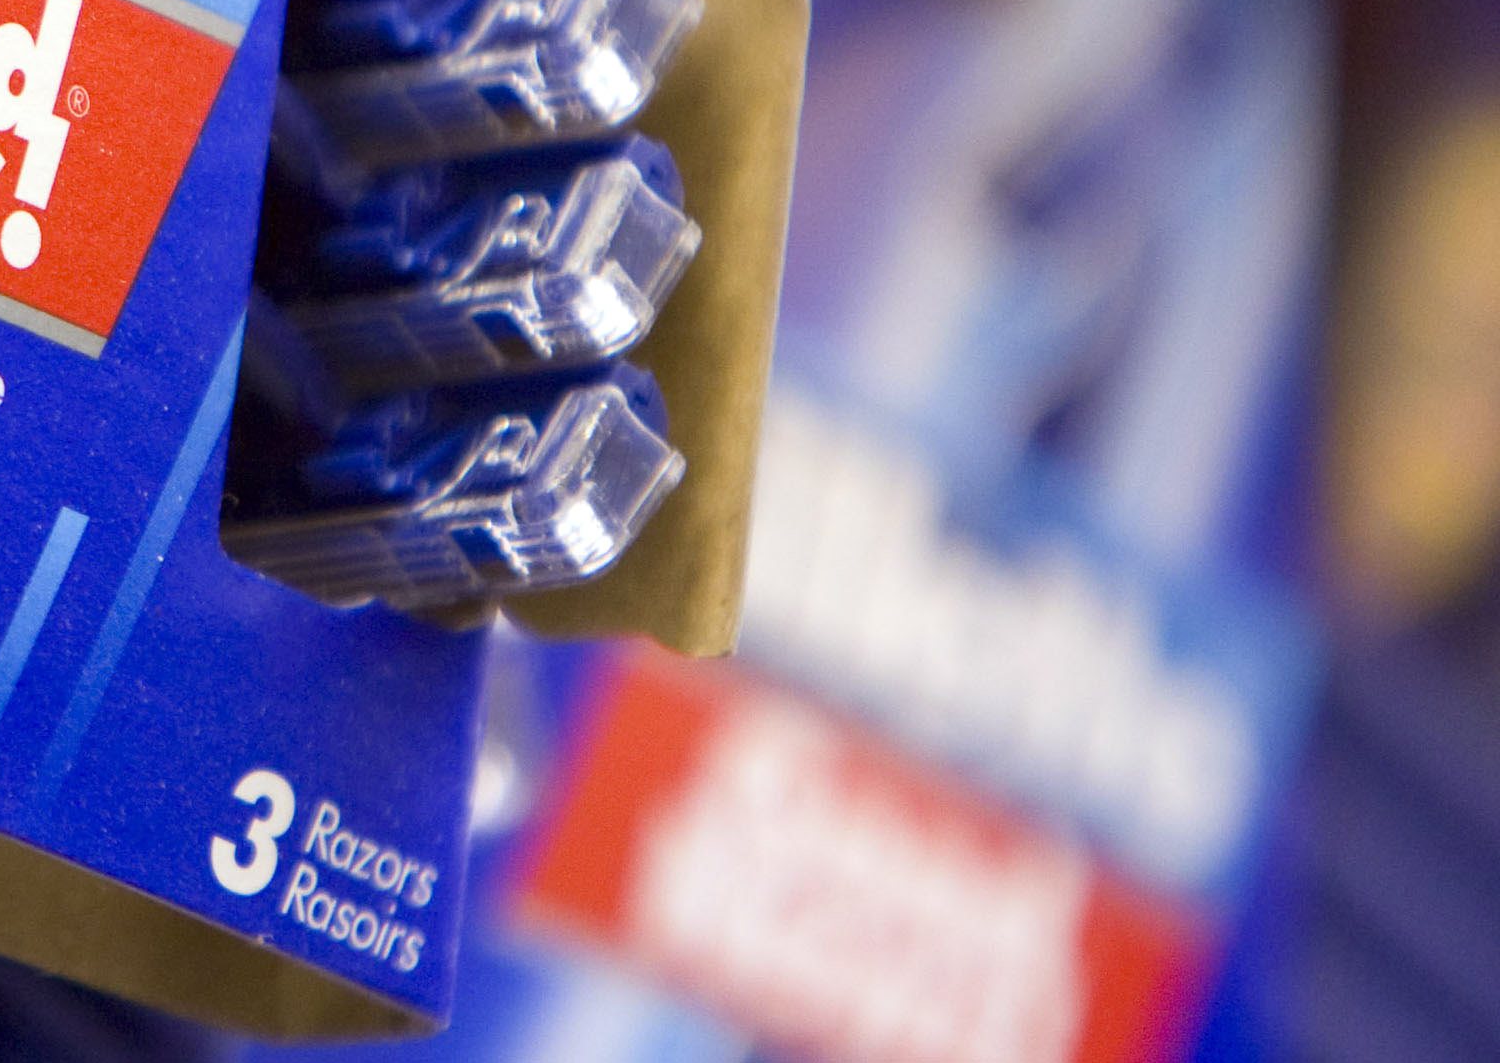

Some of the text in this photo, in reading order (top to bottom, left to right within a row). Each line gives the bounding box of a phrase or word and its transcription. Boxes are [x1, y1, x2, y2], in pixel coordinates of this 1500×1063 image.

[210, 769, 296, 897] 3
[304, 801, 439, 908] Razors
[281, 861, 425, 973] Rasoirs
